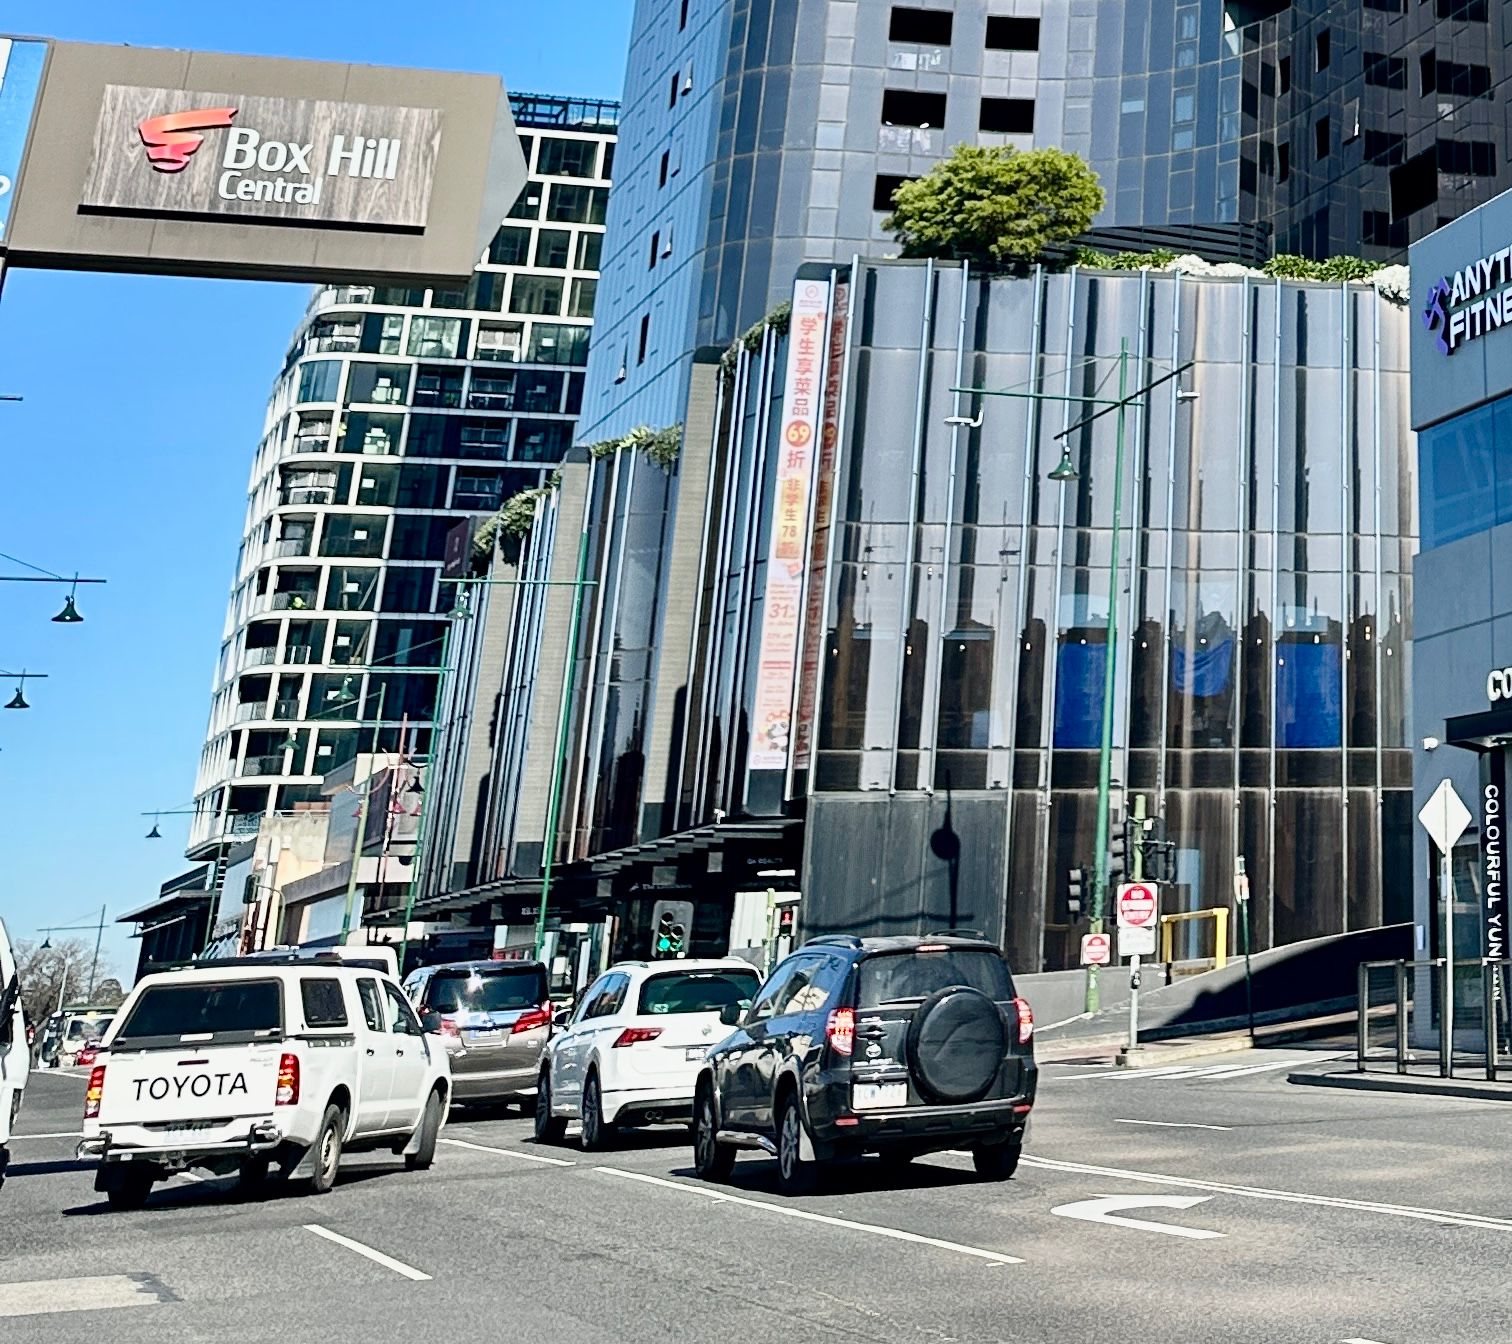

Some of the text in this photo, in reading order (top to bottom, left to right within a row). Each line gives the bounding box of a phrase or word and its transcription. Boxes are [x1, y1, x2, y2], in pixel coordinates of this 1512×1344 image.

[221, 126, 401, 180] Box Hill
[218, 170, 324, 205] Central
[1484, 784, 1503, 909] COLOURFUL
[132, 1072, 249, 1102] TOYOTA
